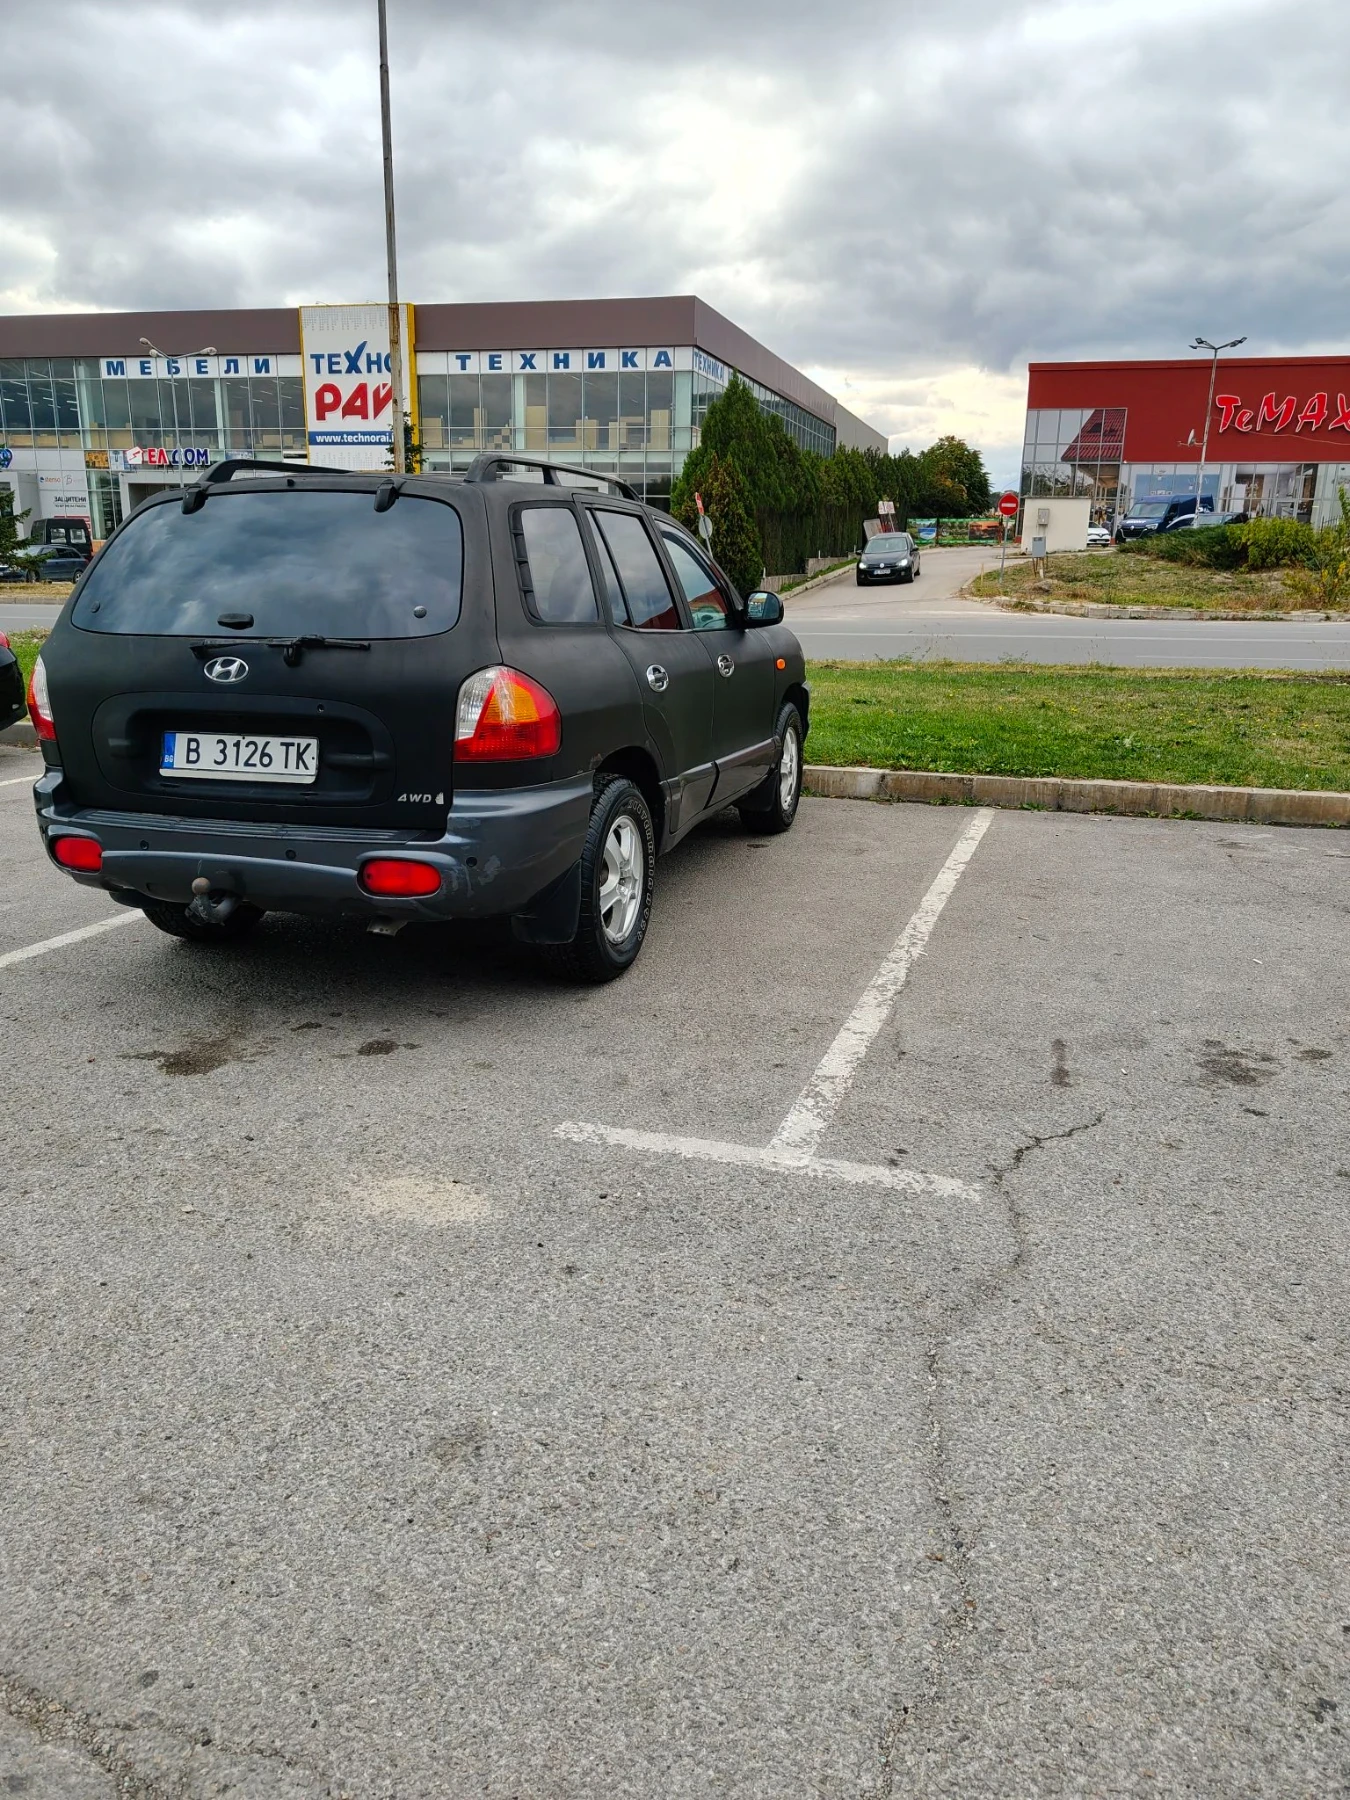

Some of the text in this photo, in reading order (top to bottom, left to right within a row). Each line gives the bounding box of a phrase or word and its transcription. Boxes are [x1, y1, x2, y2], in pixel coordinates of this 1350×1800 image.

[106, 358, 270, 376] МЕБЕЛИ
[455, 351, 672, 371] ТЕХНИКА
[1216, 392, 1350, 433] TeMAX
[164, 754, 174, 763] BG
[185, 737, 312, 770] B 3126 TK
[397, 793, 432, 803] 4WD
